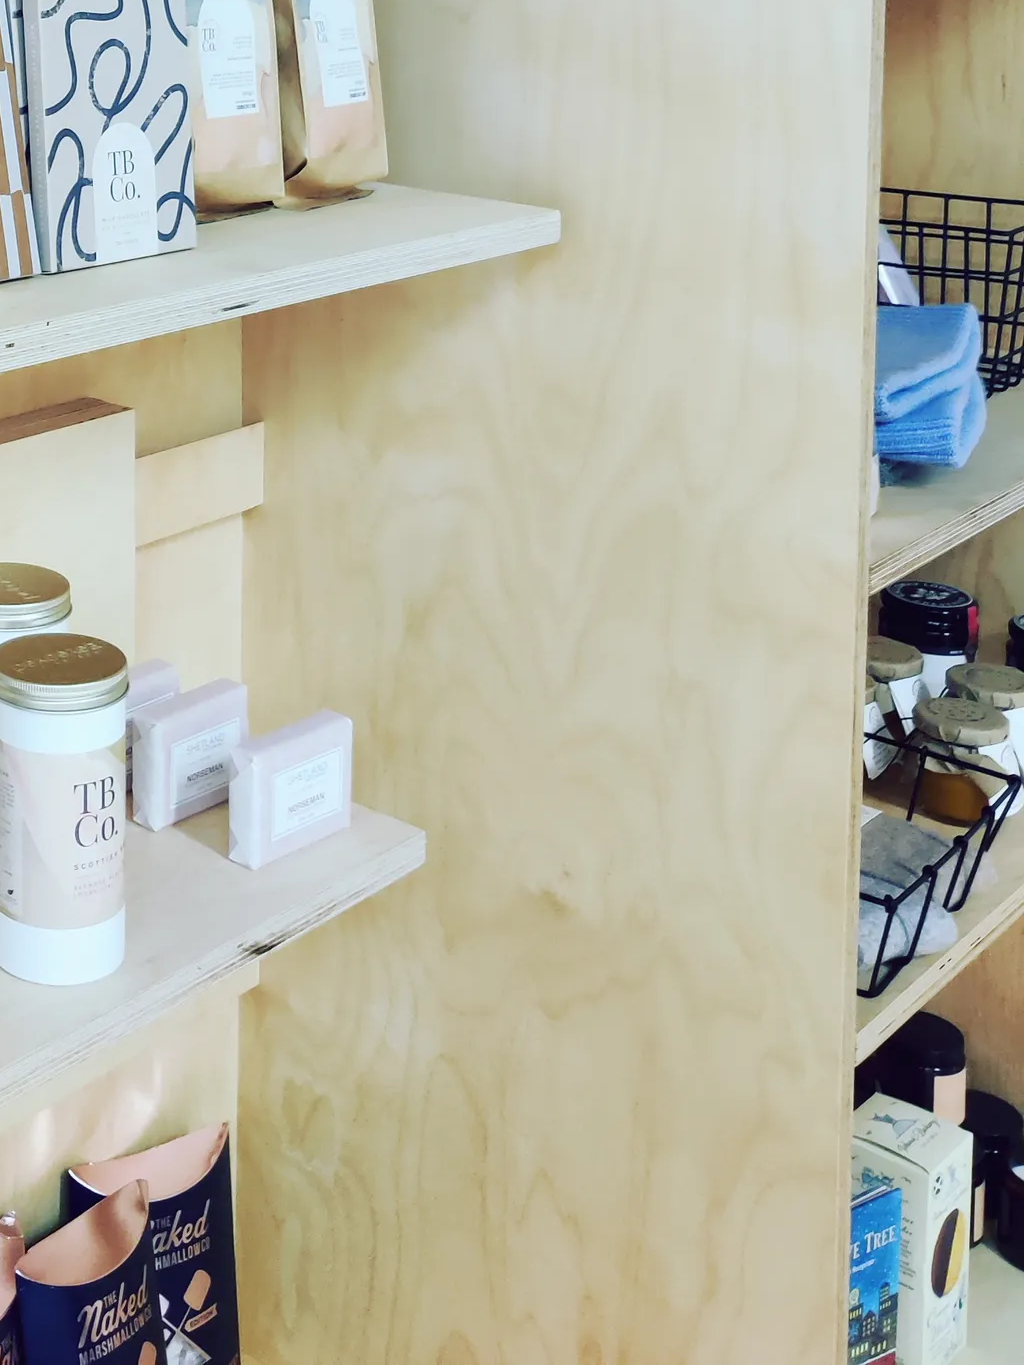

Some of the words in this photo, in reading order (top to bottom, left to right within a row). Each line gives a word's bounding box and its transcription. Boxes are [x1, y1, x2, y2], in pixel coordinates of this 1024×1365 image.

[202, 28, 215, 41] TB
[108, 150, 135, 176] TB
[110, 177, 140, 202] Co.
[187, 762, 223, 782] NORSEMAN
[74, 776, 115, 815] TB
[287, 792, 325, 813] NORSEMAN
[75, 815, 118, 848] Co.
[150, 1198, 211, 1255] aked
[155, 1216, 171, 1230] THE
[864, 1225, 898, 1254] TREE
[77, 1264, 148, 1349] Naked
[103, 1290, 117, 1308] THE
[189, 1308, 214, 1328] EDITION
